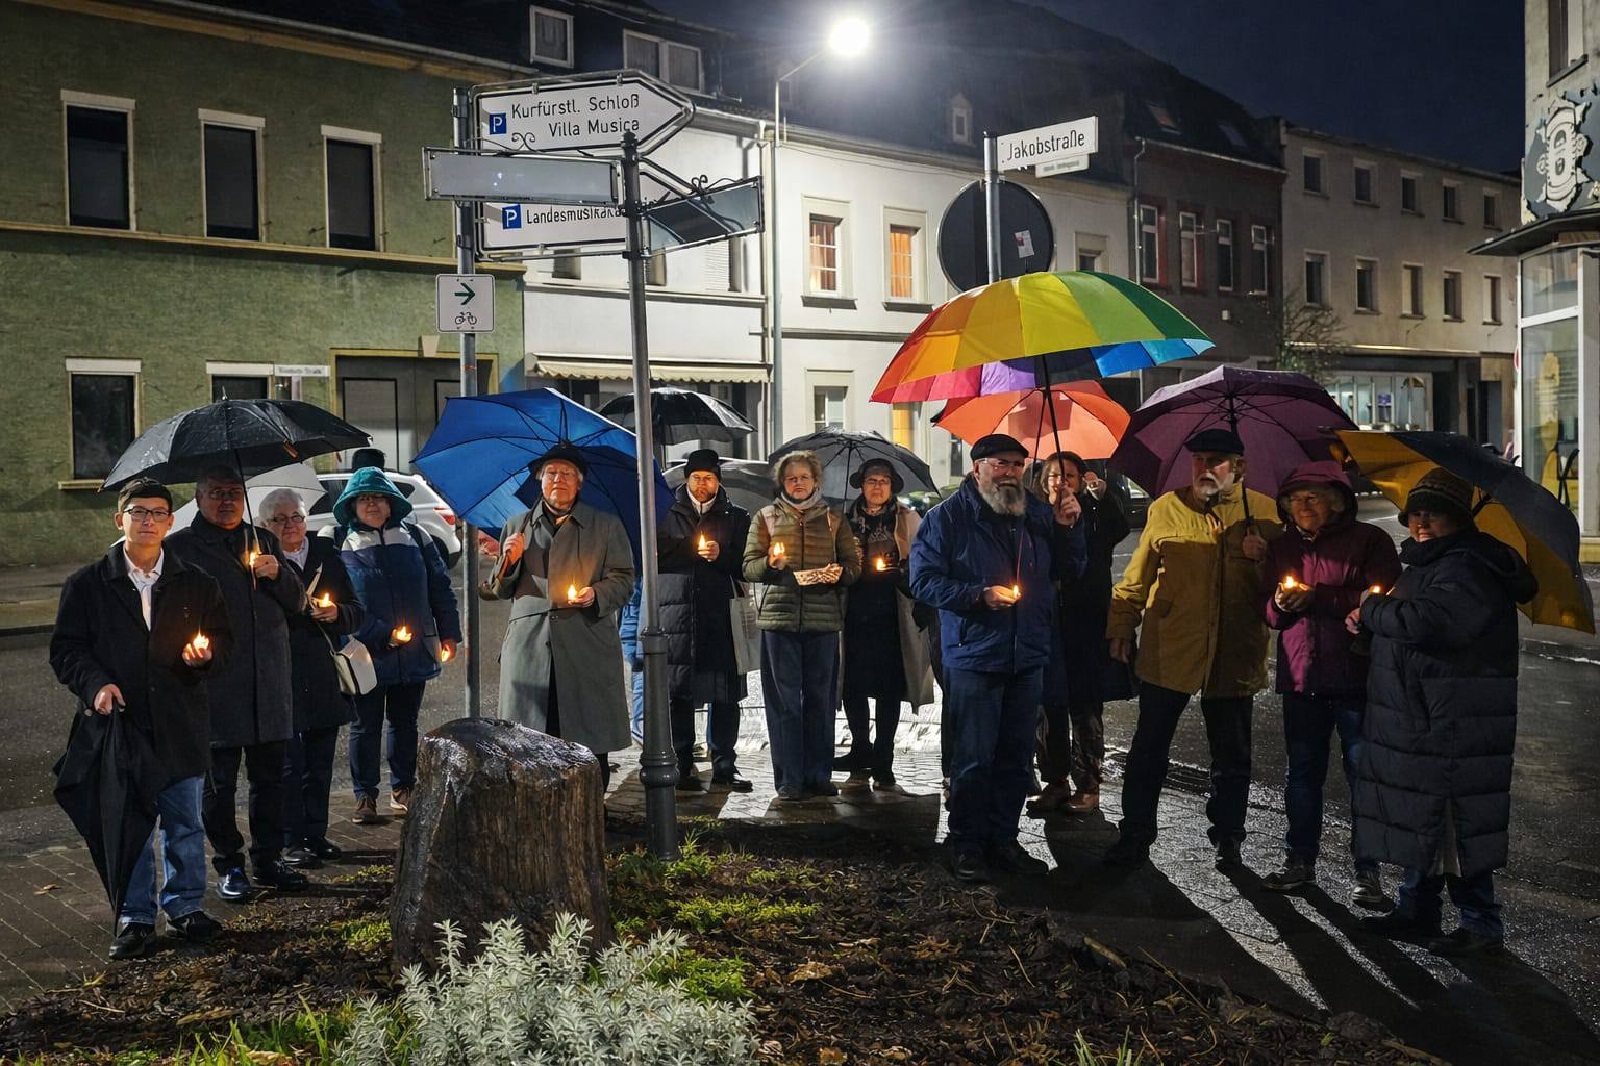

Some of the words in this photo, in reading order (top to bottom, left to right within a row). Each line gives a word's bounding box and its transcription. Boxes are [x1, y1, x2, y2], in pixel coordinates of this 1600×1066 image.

[511, 97, 580, 119] Kurfürstl.
[589, 94, 638, 110] Schloß
[548, 121, 580, 137] Villa
[588, 117, 640, 133] Musica
[1007, 129, 1085, 161] Jakobstraße
